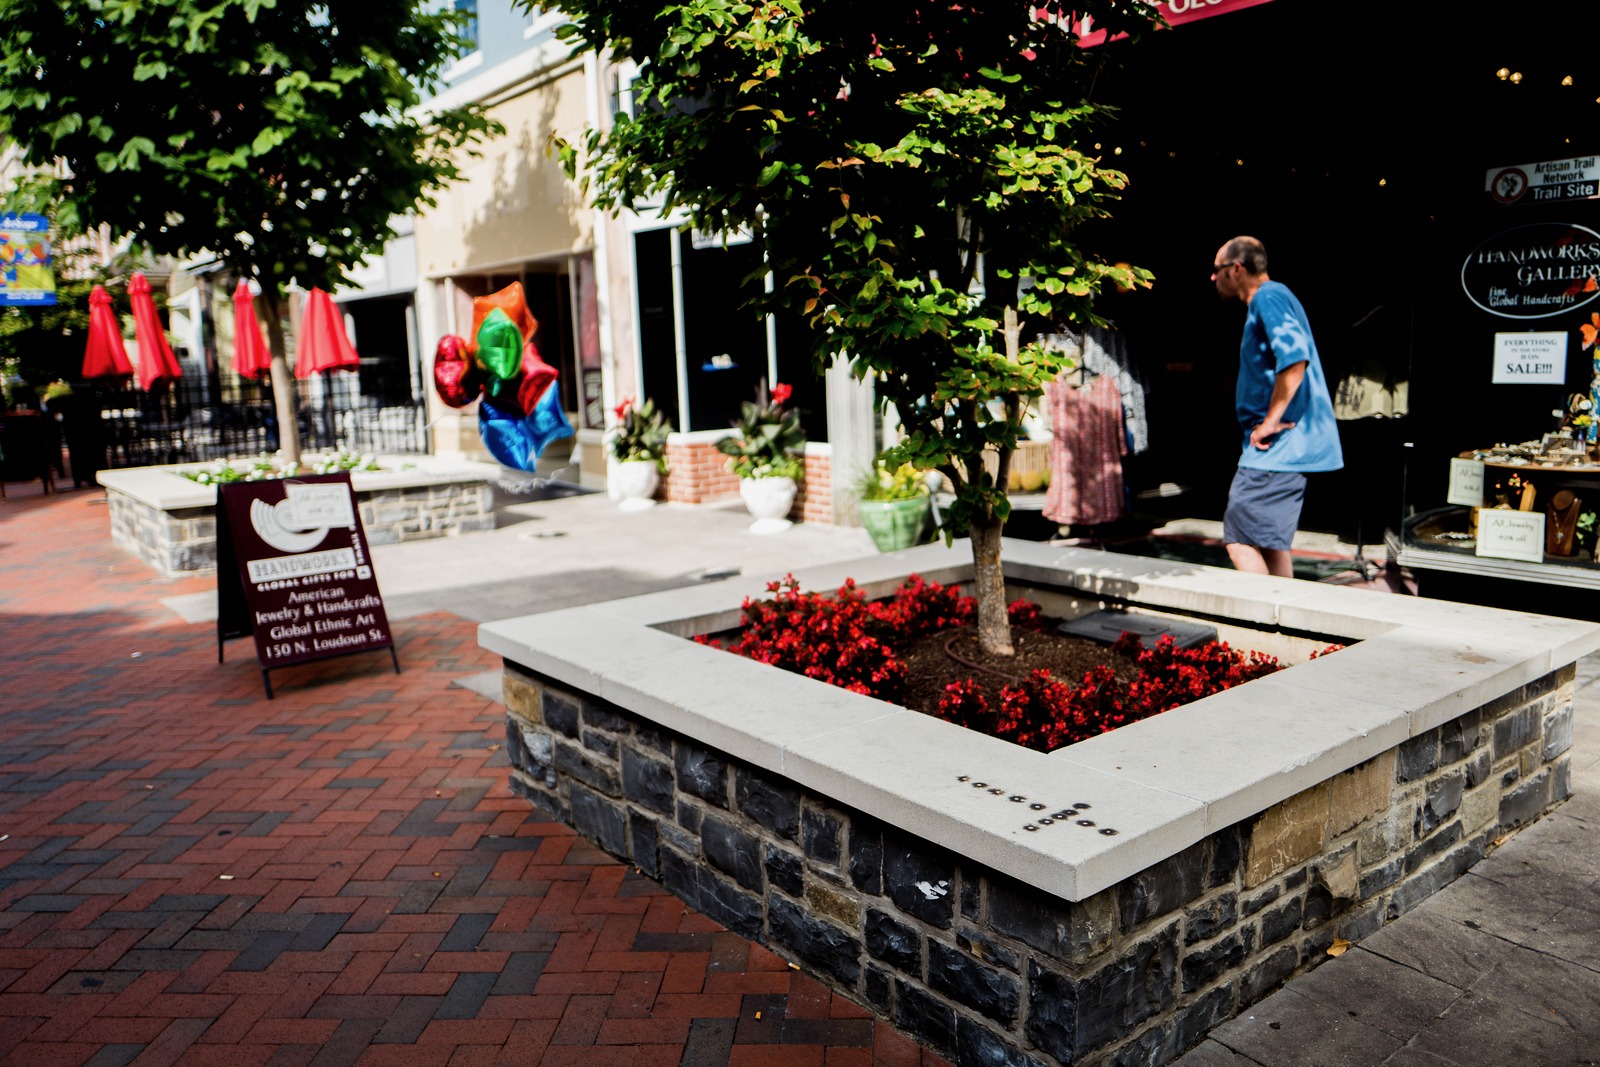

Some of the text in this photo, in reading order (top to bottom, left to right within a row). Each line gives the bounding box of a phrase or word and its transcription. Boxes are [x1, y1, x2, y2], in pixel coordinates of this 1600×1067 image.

[1535, 157, 1595, 174] Artisan Trail
[1543, 170, 1584, 184] Network
[1533, 183, 1594, 200] Trail Site
[1478, 243, 1600, 264] HANDWORKS
[1489, 293, 1575, 308] Global Handcrafts
[1506, 362, 1553, 375] SALE!!!
[254, 551, 351, 577] HANDWORKS
[257, 578, 299, 592] GLOBAL
[301, 573, 331, 586] GIFTS
[333, 569, 355, 581] FOR
[288, 587, 345, 605] American
[255, 594, 381, 625] Jewelry & Handcrafts
[270, 613, 376, 640] Global Ethnic Art
[266, 628, 386, 659] 150 N. Loudoun St.
